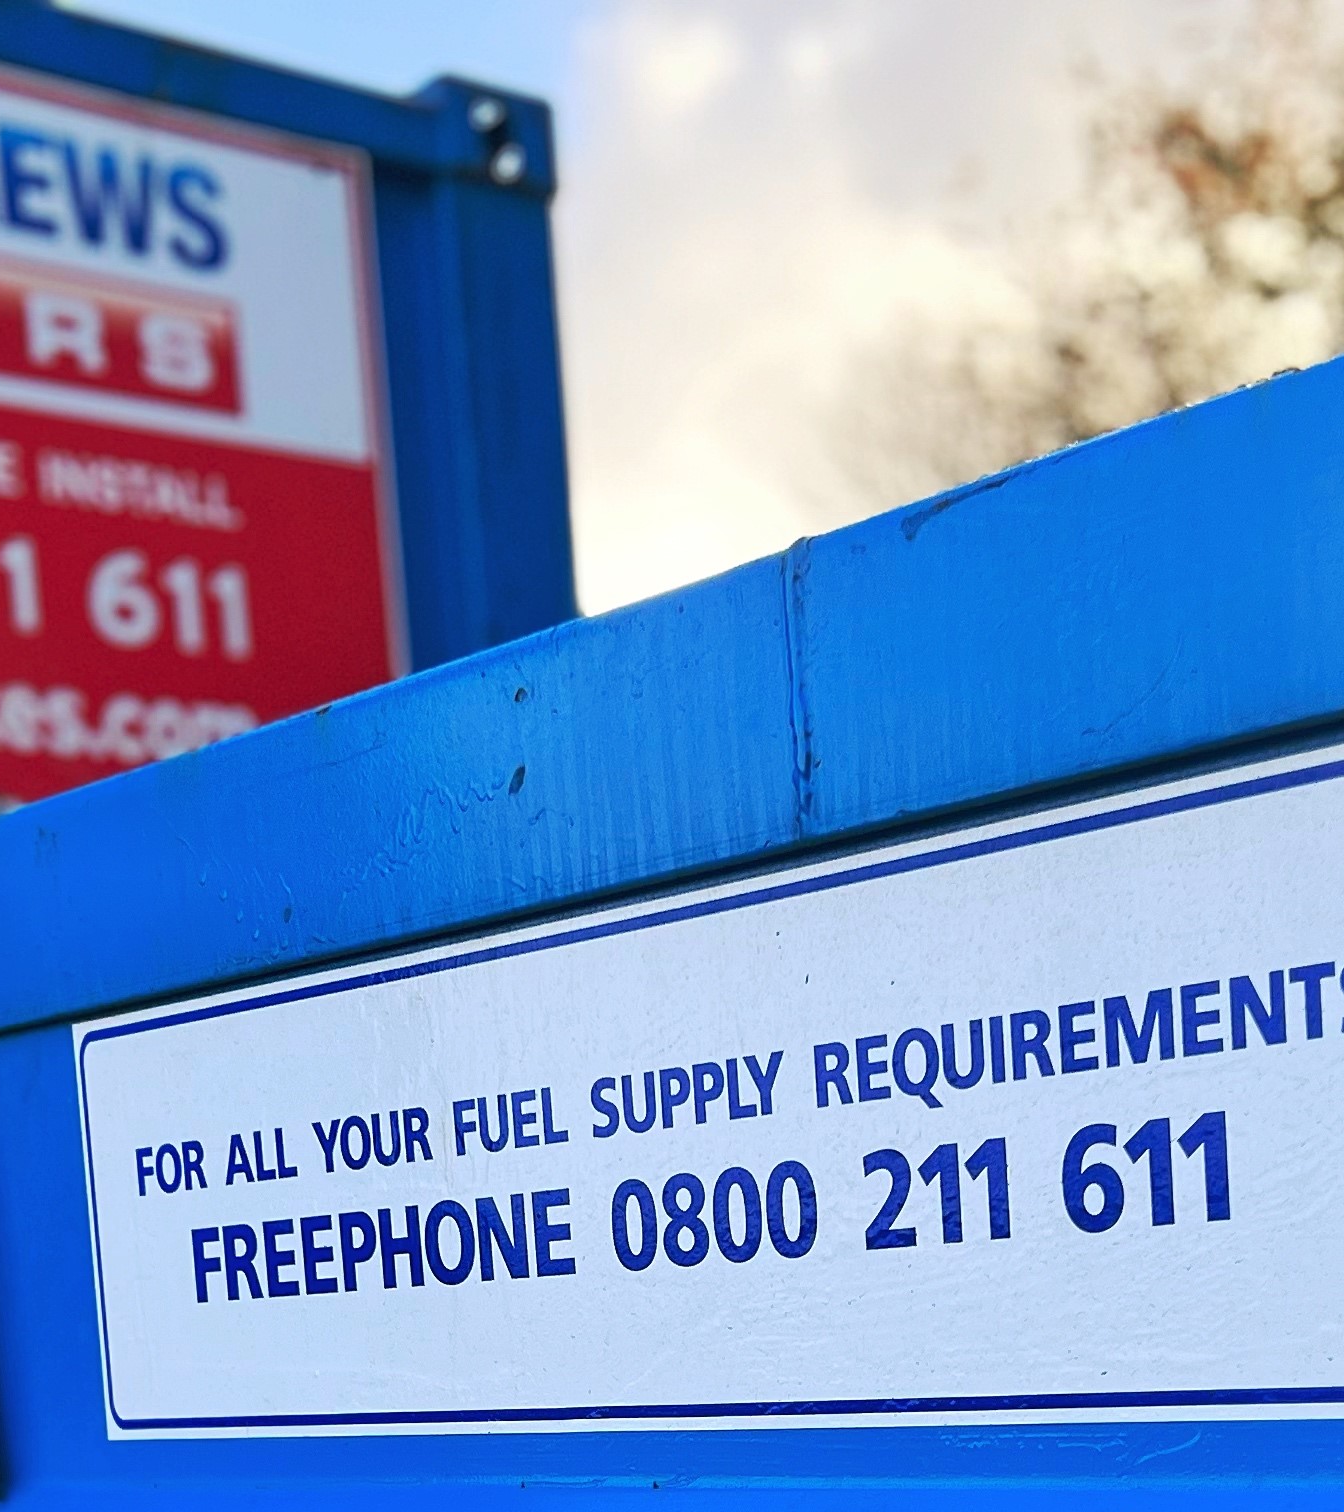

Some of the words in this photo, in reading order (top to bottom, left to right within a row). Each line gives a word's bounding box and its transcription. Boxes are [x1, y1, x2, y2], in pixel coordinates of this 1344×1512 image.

[38, 449, 244, 533] INSTALL
[87, 549, 254, 662] 611
[134, 1139, 209, 1198] FOR
[224, 1126, 300, 1187] ALL
[310, 1105, 435, 1175] YOUR
[451, 1085, 571, 1158] FUEL
[589, 1048, 786, 1140] SUPPLY
[189, 1186, 578, 1305] FREEPHONE
[610, 1159, 819, 1273] 0800
[861, 1135, 1013, 1252] 211
[1060, 1109, 1232, 1235] 611
